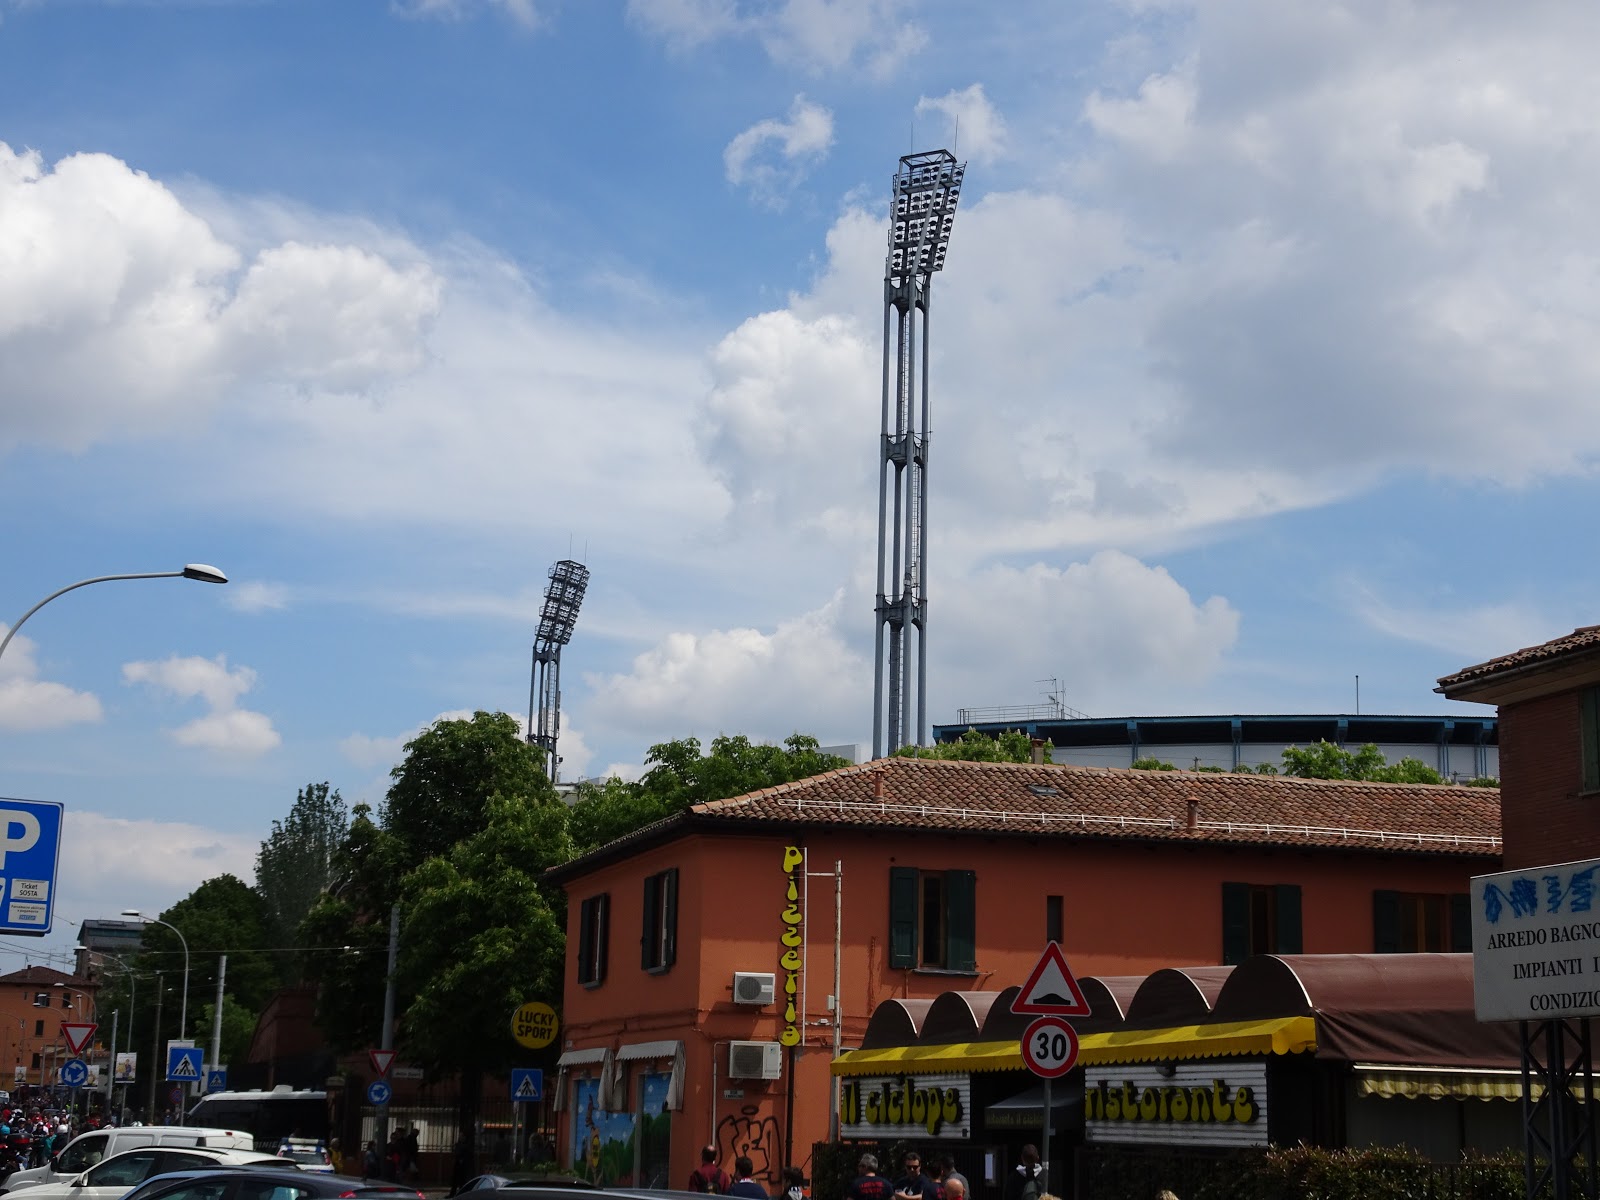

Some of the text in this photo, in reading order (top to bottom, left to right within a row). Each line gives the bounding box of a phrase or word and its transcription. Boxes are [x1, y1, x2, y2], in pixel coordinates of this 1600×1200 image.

[19, 889, 38, 897] SOSTA
[20, 882, 38, 890] Ticket
[1487, 928, 1547, 950] ARREDO
[1513, 958, 1583, 980] IMPIANTI
[519, 1010, 555, 1026] LUCKY
[517, 1024, 552, 1040] SPORT
[1035, 1032, 1067, 1061] 30
[865, 1078, 961, 1136] ciclope
[1084, 1078, 1258, 1123] ristorante
